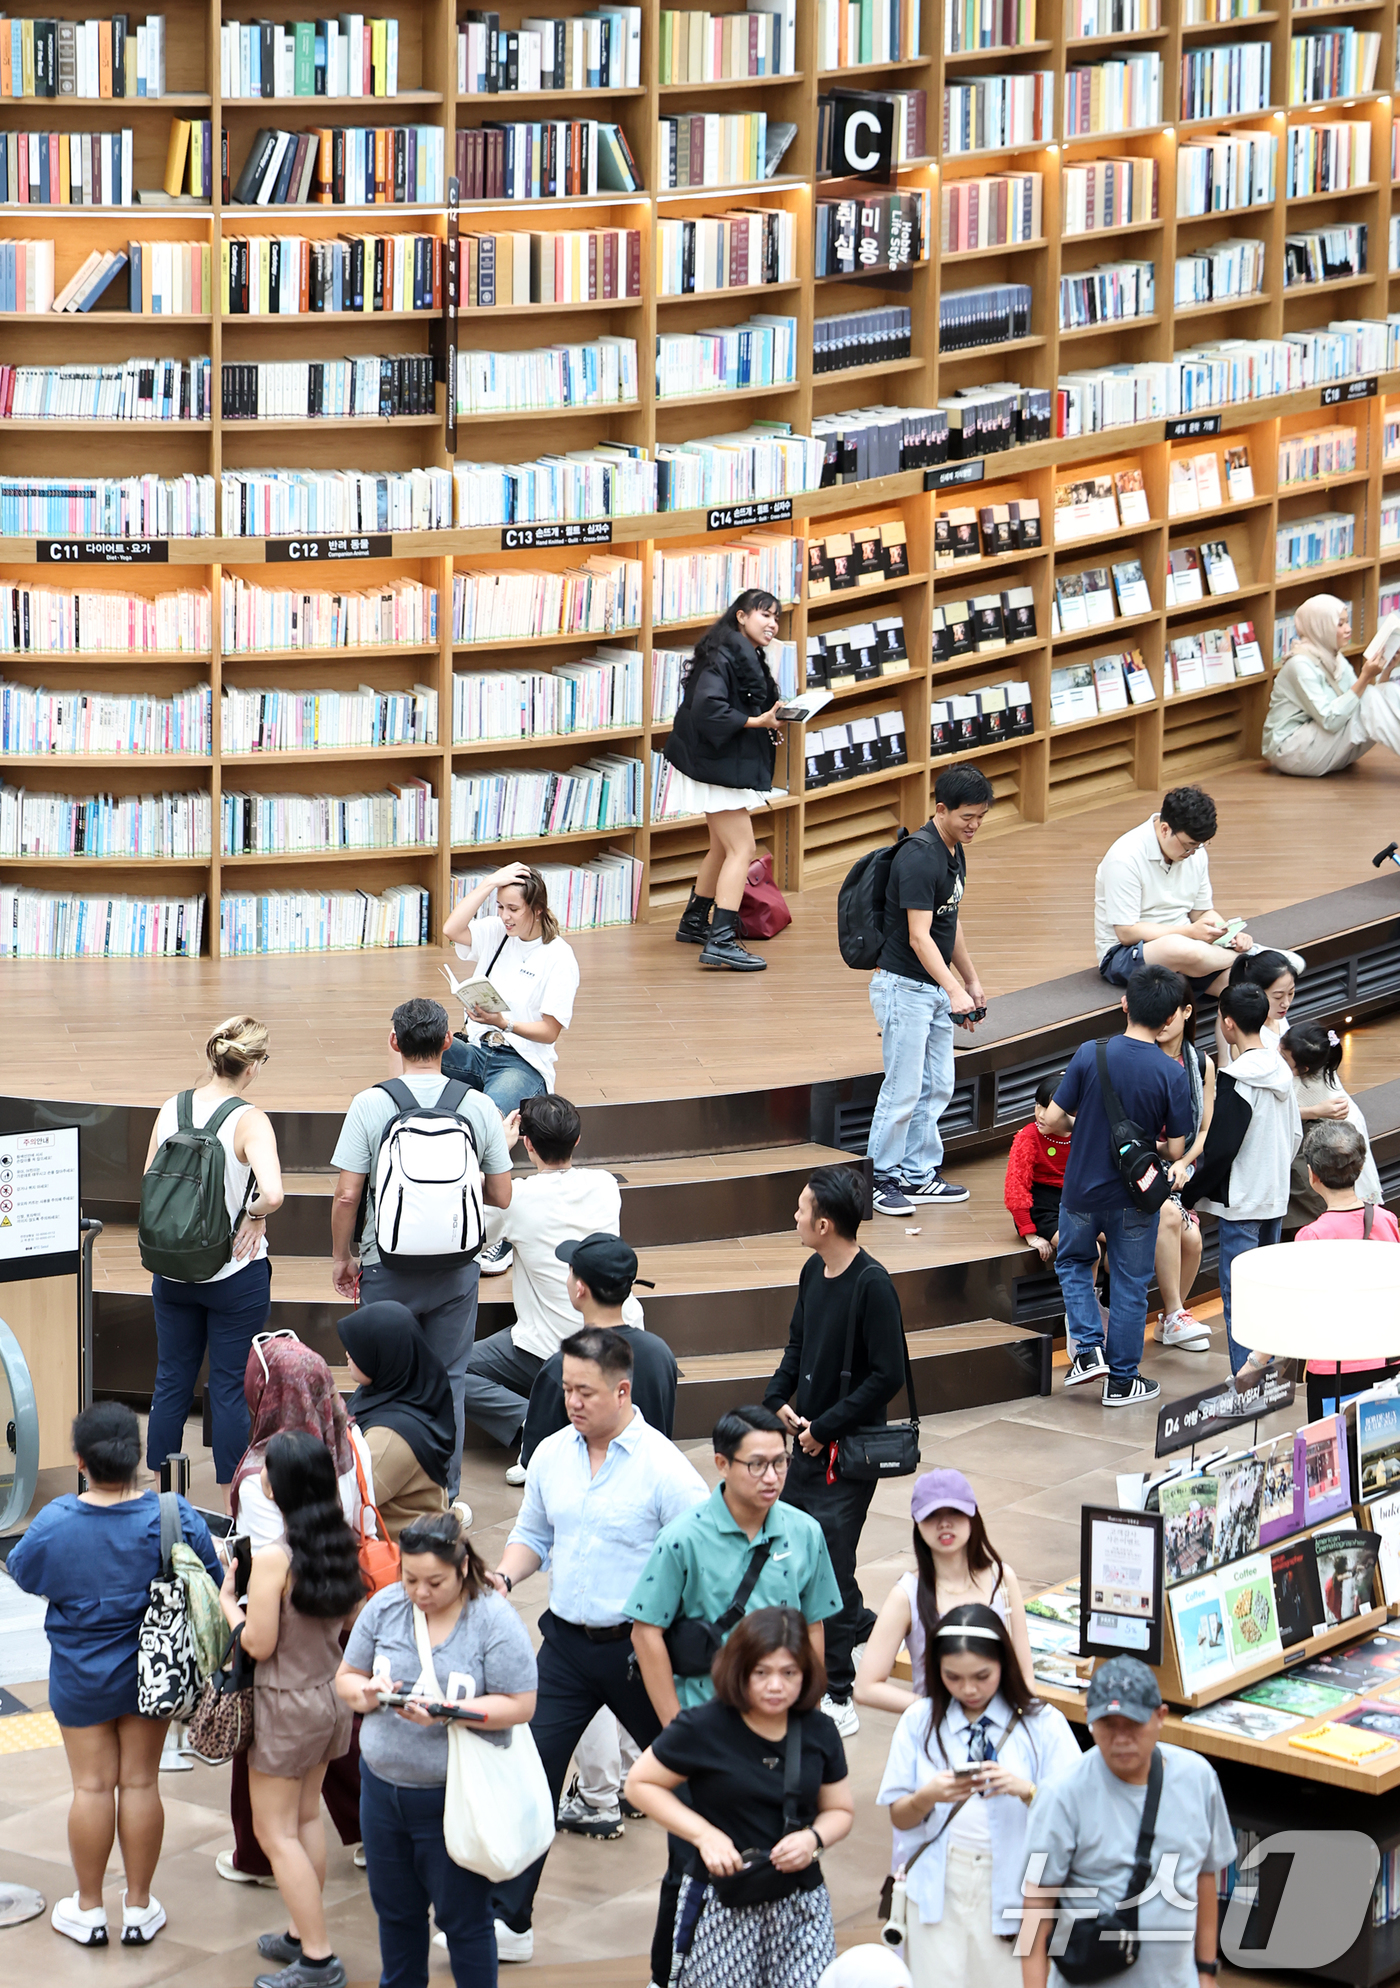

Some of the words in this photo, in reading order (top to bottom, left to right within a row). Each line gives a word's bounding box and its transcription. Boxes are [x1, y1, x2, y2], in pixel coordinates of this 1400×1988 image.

[844, 110, 882, 171] C
[891, 210, 902, 236] Life
[899, 221, 912, 264] Hobby
[888, 237, 900, 271] Style
[710, 511, 732, 528] C14
[328, 540, 347, 550] 반려
[350, 538, 369, 549] 동물
[506, 529, 533, 546] C13
[50, 543, 79, 560] C11
[289, 542, 319, 559] C12
[23, 1136, 49, 1146] 주의안내
[1164, 1417, 1179, 1438] D4
[1315, 1534, 1341, 1548] American
[1315, 1538, 1367, 1556] Cinematographer
[1233, 1566, 1258, 1582] Coffee
[1185, 1588, 1207, 1603] Coffee
